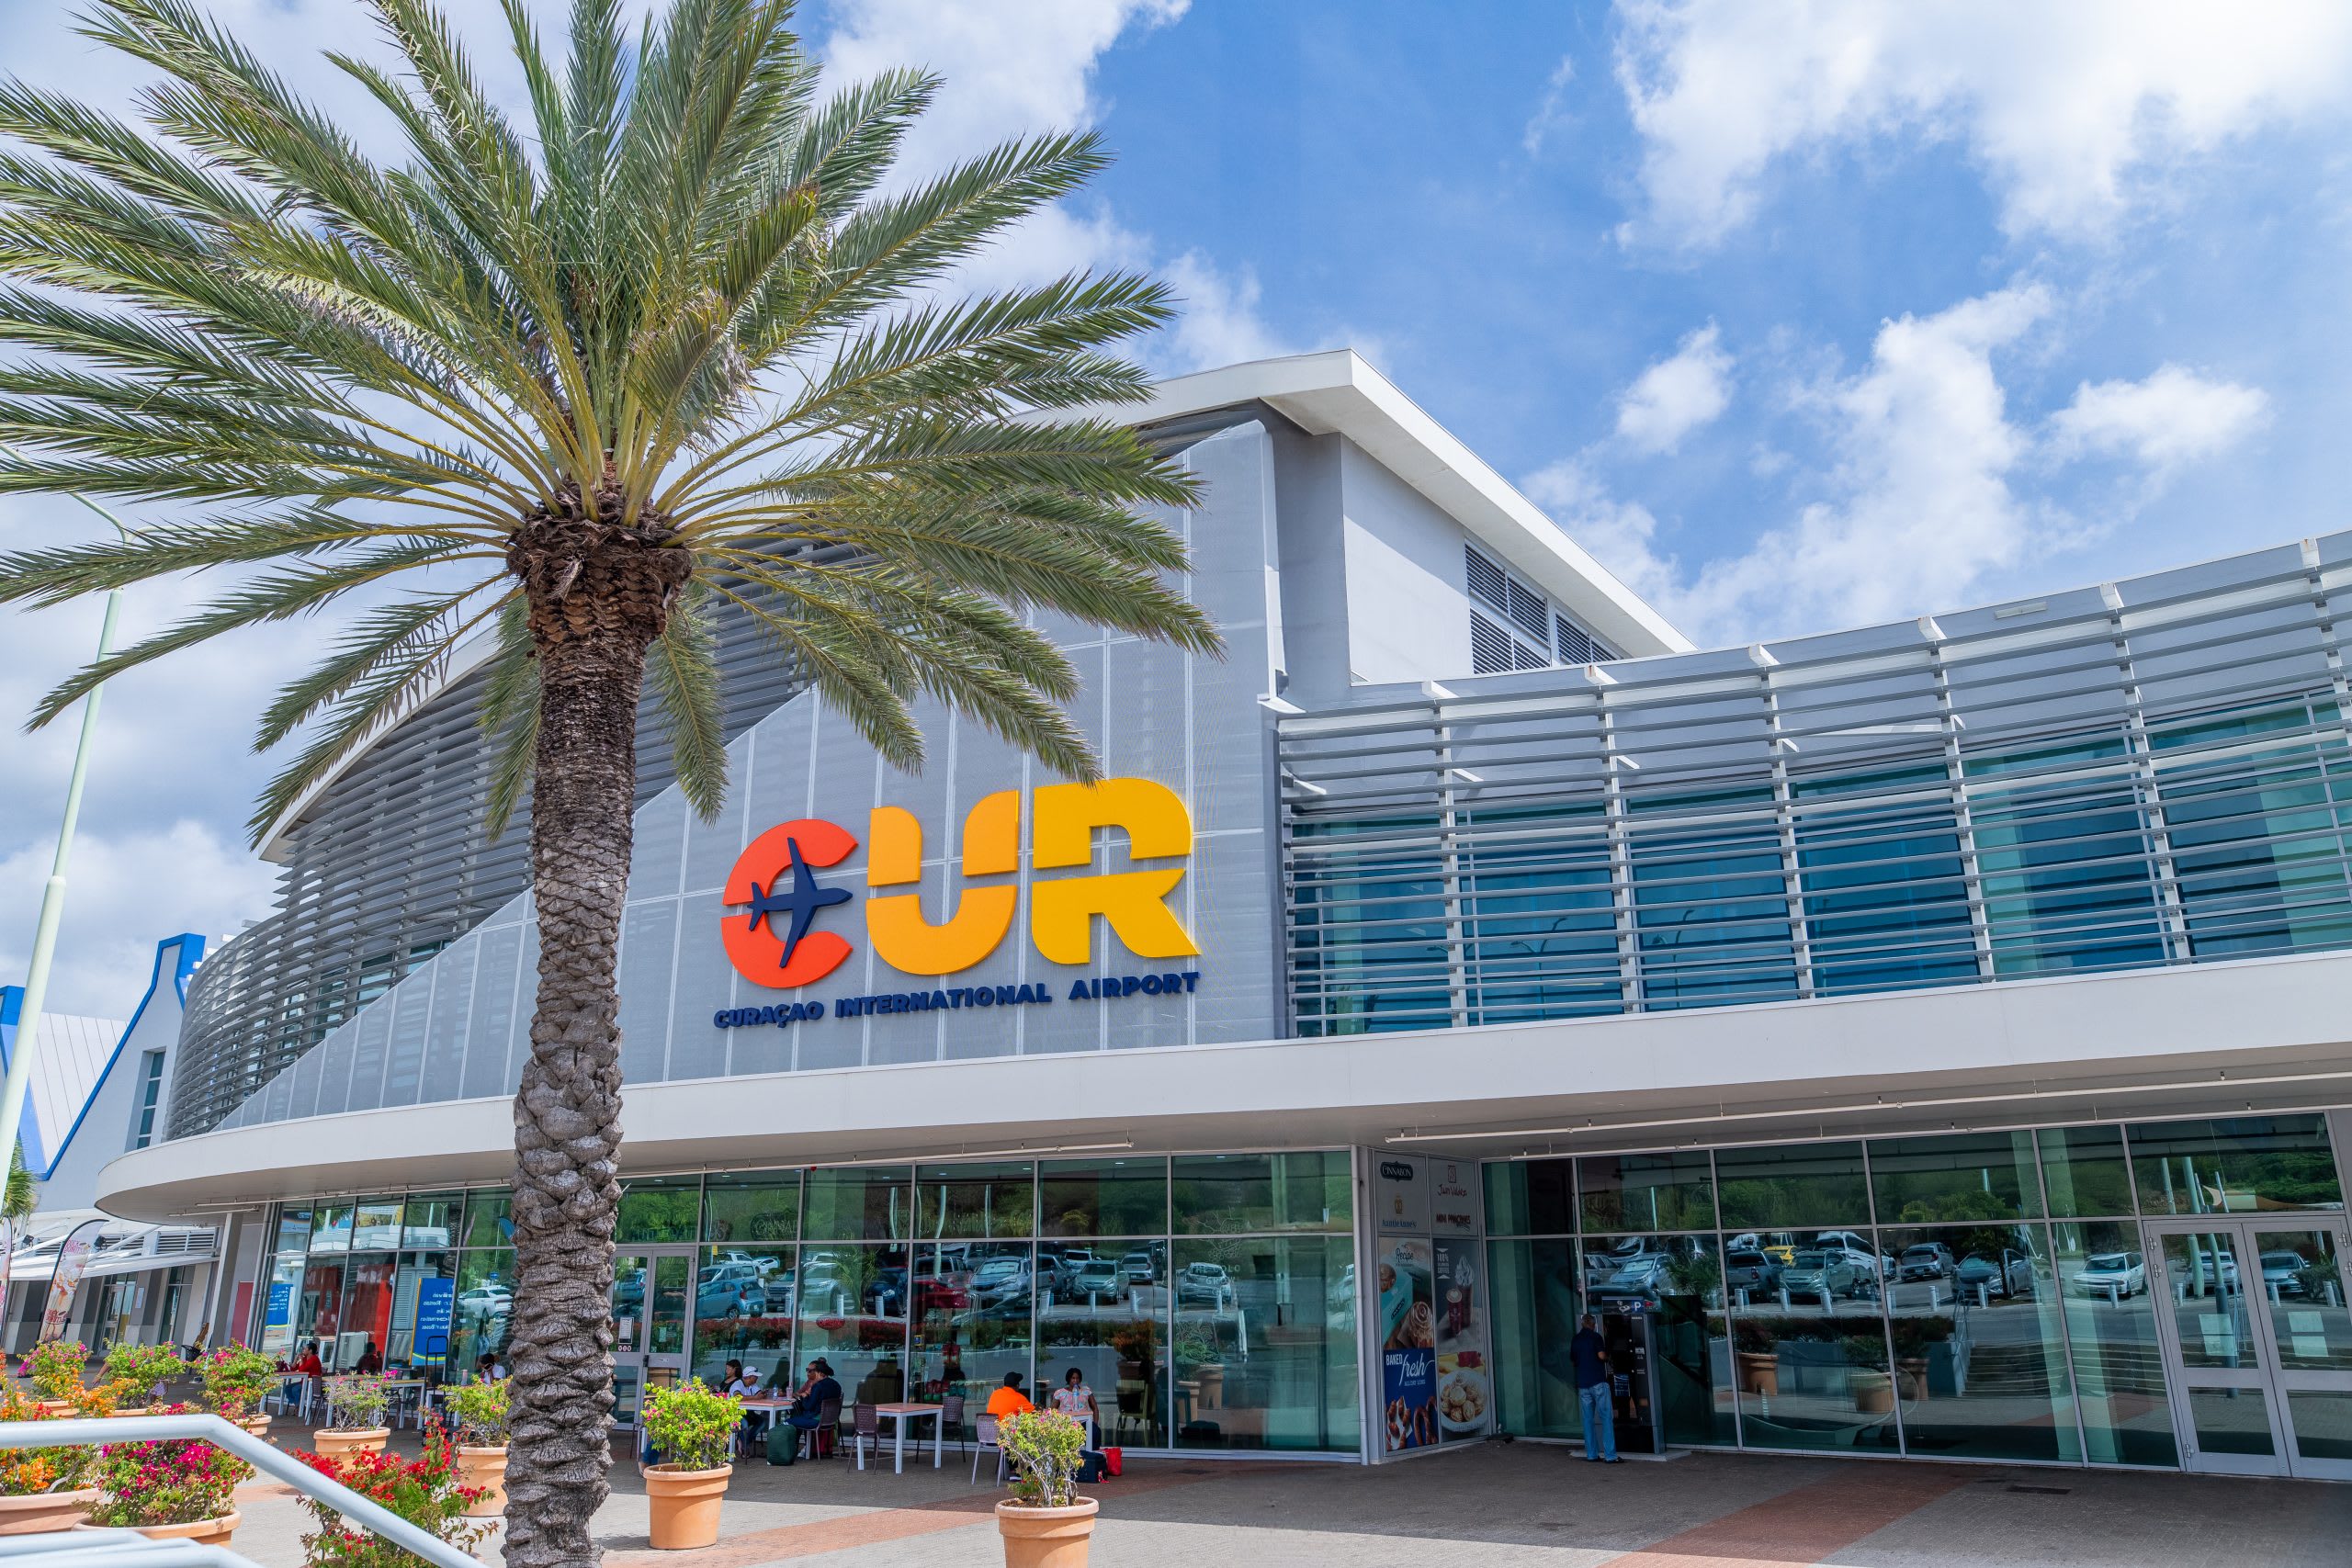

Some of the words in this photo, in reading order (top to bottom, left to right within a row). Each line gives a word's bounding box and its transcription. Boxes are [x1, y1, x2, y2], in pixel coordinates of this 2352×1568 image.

[720, 777, 1200, 988] CUR
[713, 1000, 825, 1029] CURAÇAO
[835, 982, 1052, 1018] INTERNATIONAL
[1069, 971, 1200, 1000] AIRPORT
[1382, 1165, 1412, 1177] CINNABON
[1385, 1353, 1403, 1366] BAKED
[1398, 1352, 1434, 1386] fresh
